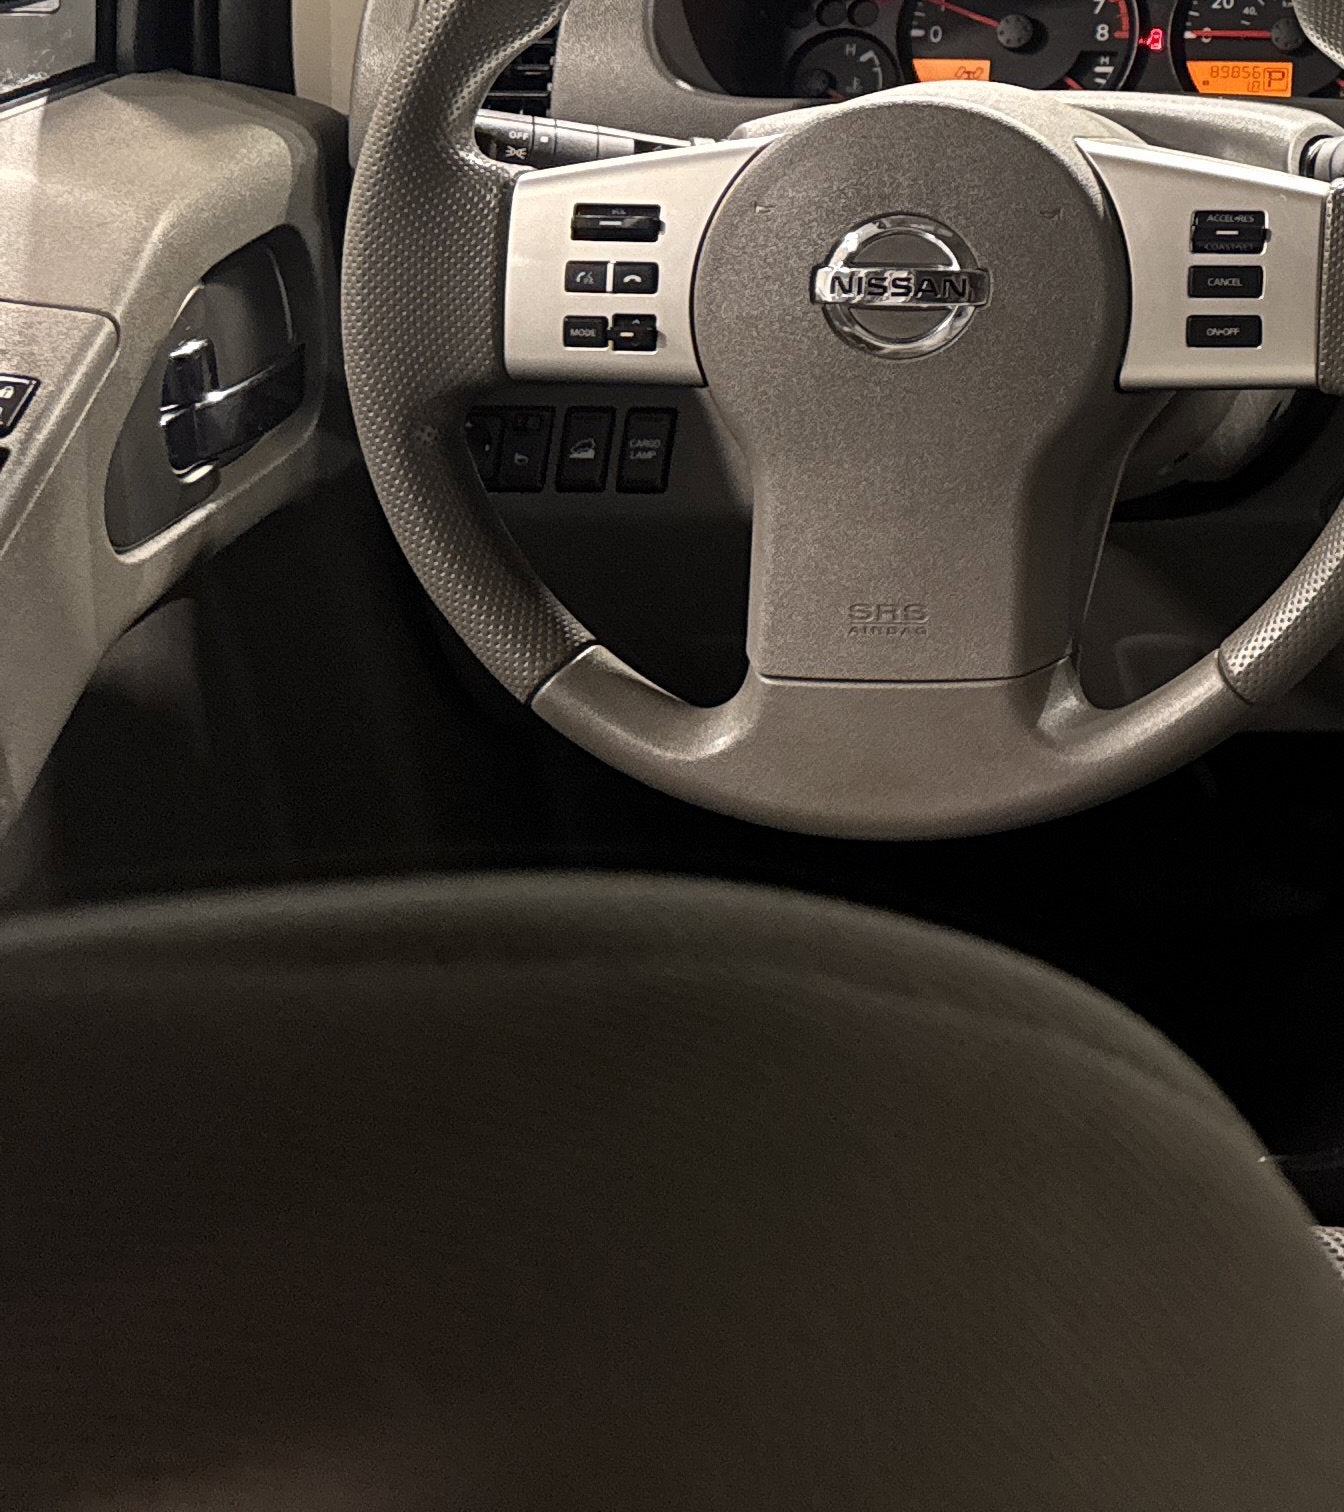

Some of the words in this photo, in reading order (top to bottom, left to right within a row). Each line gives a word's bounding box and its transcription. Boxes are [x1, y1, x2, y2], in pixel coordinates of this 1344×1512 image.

[929, 26, 943, 43] 0
[1095, 24, 1109, 42] 8
[845, 43, 857, 56] H
[1266, 70, 1286, 87] P
[508, 130, 529, 141] OFF
[830, 276, 969, 298] NISSAN
[1207, 277, 1243, 287] CANCEL
[569, 327, 596, 337] MODE
[847, 602, 930, 623] SRS
